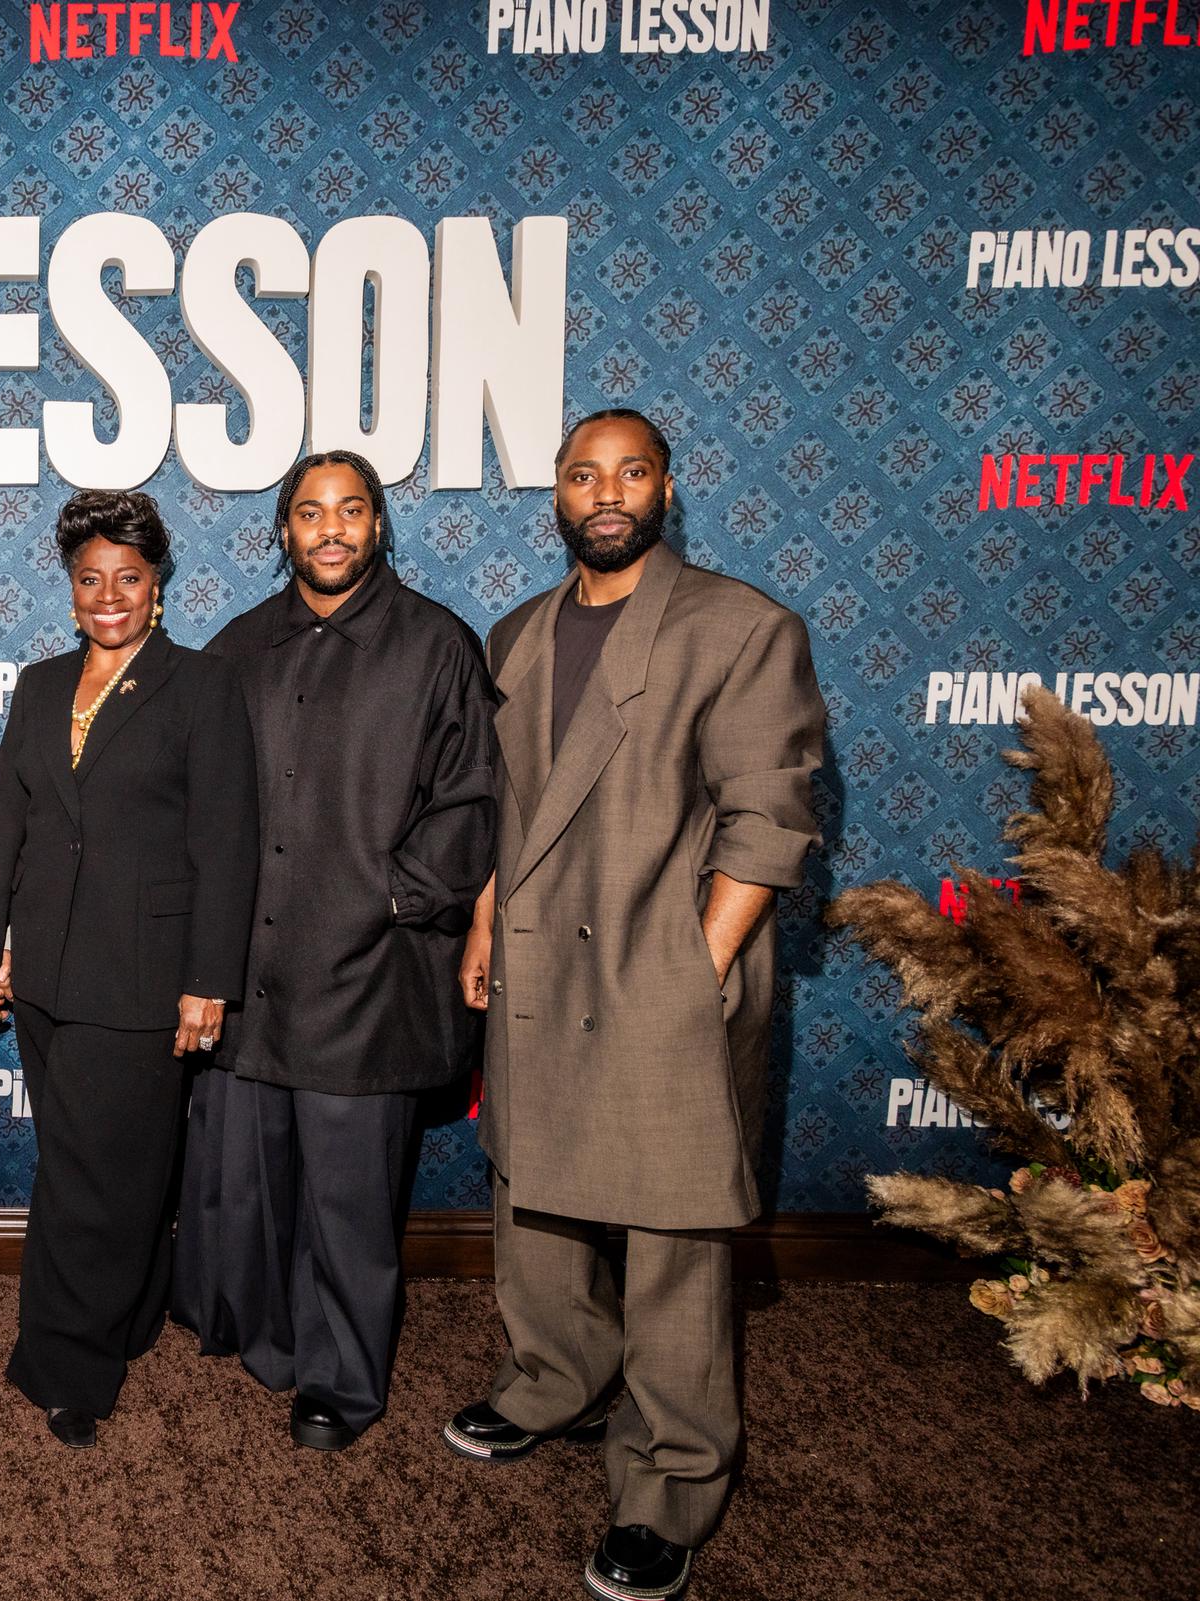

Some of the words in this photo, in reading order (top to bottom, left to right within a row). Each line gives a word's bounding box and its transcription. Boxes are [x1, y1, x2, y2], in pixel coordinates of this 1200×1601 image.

[29, 2, 241, 64] NETFLIX
[620, 0, 770, 54] LESSON
[1022, 0, 1200, 57] NETFL
[977, 453, 1195, 512] NETFLIX
